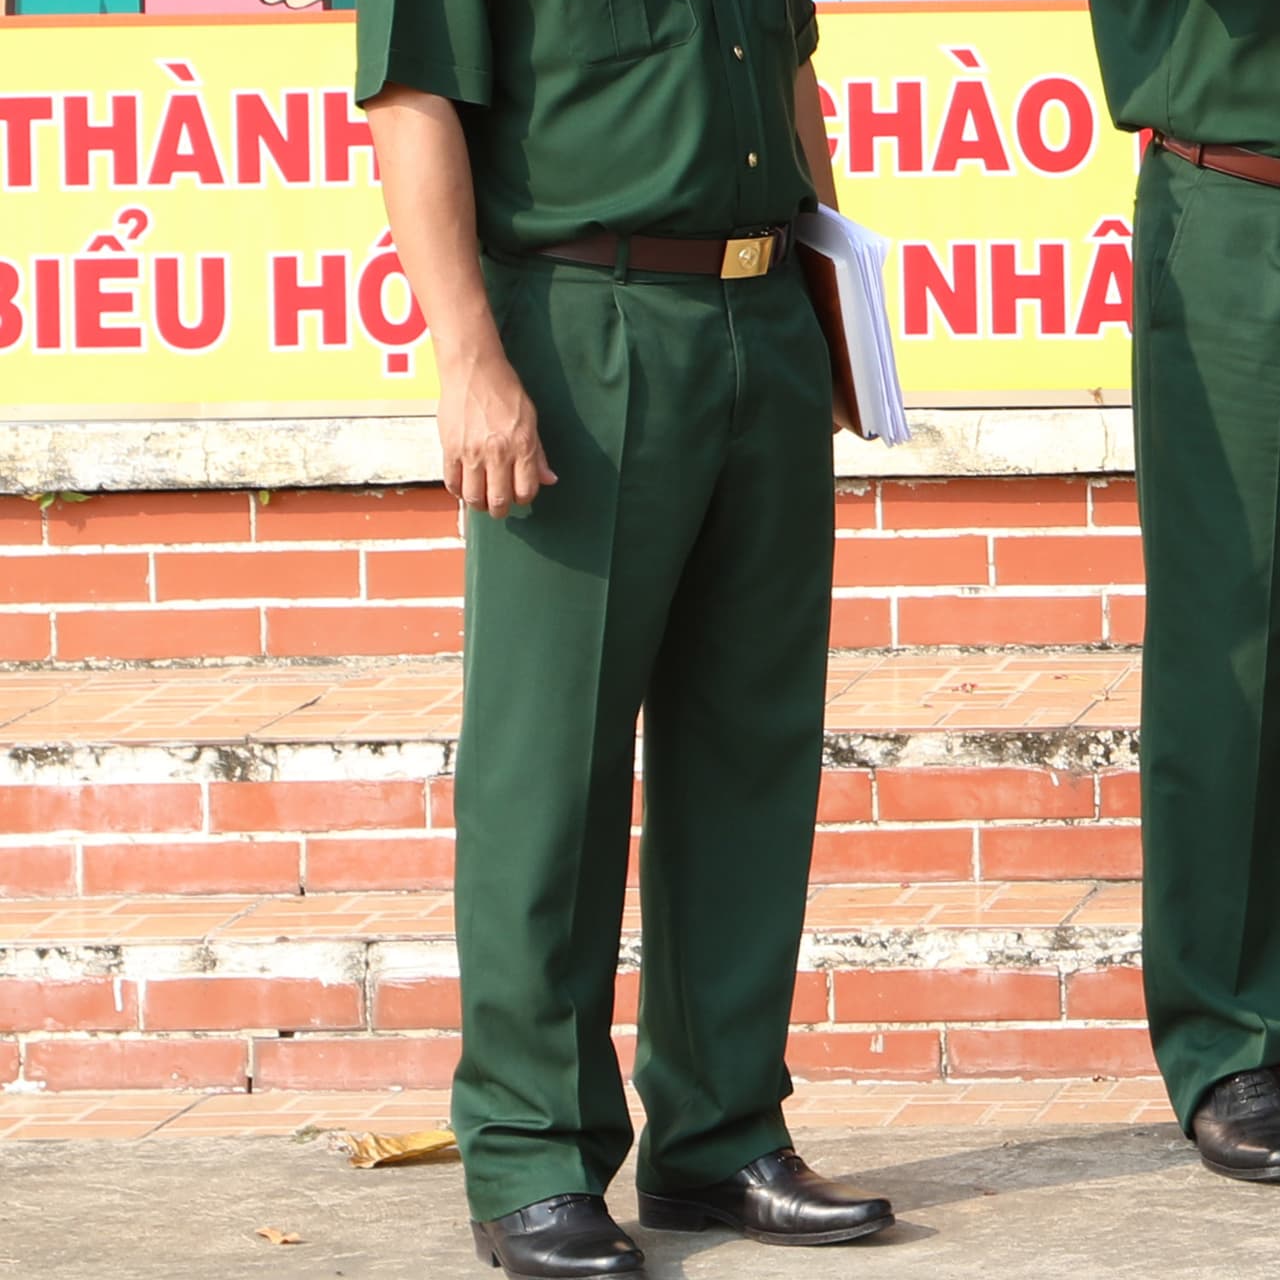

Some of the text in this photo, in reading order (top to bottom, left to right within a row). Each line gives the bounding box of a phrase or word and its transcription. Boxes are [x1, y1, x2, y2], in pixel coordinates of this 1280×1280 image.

[0, 64, 383, 186] THÀNH
[274, 230, 428, 372] HỘ
[904, 220, 1132, 334] NHÂ
